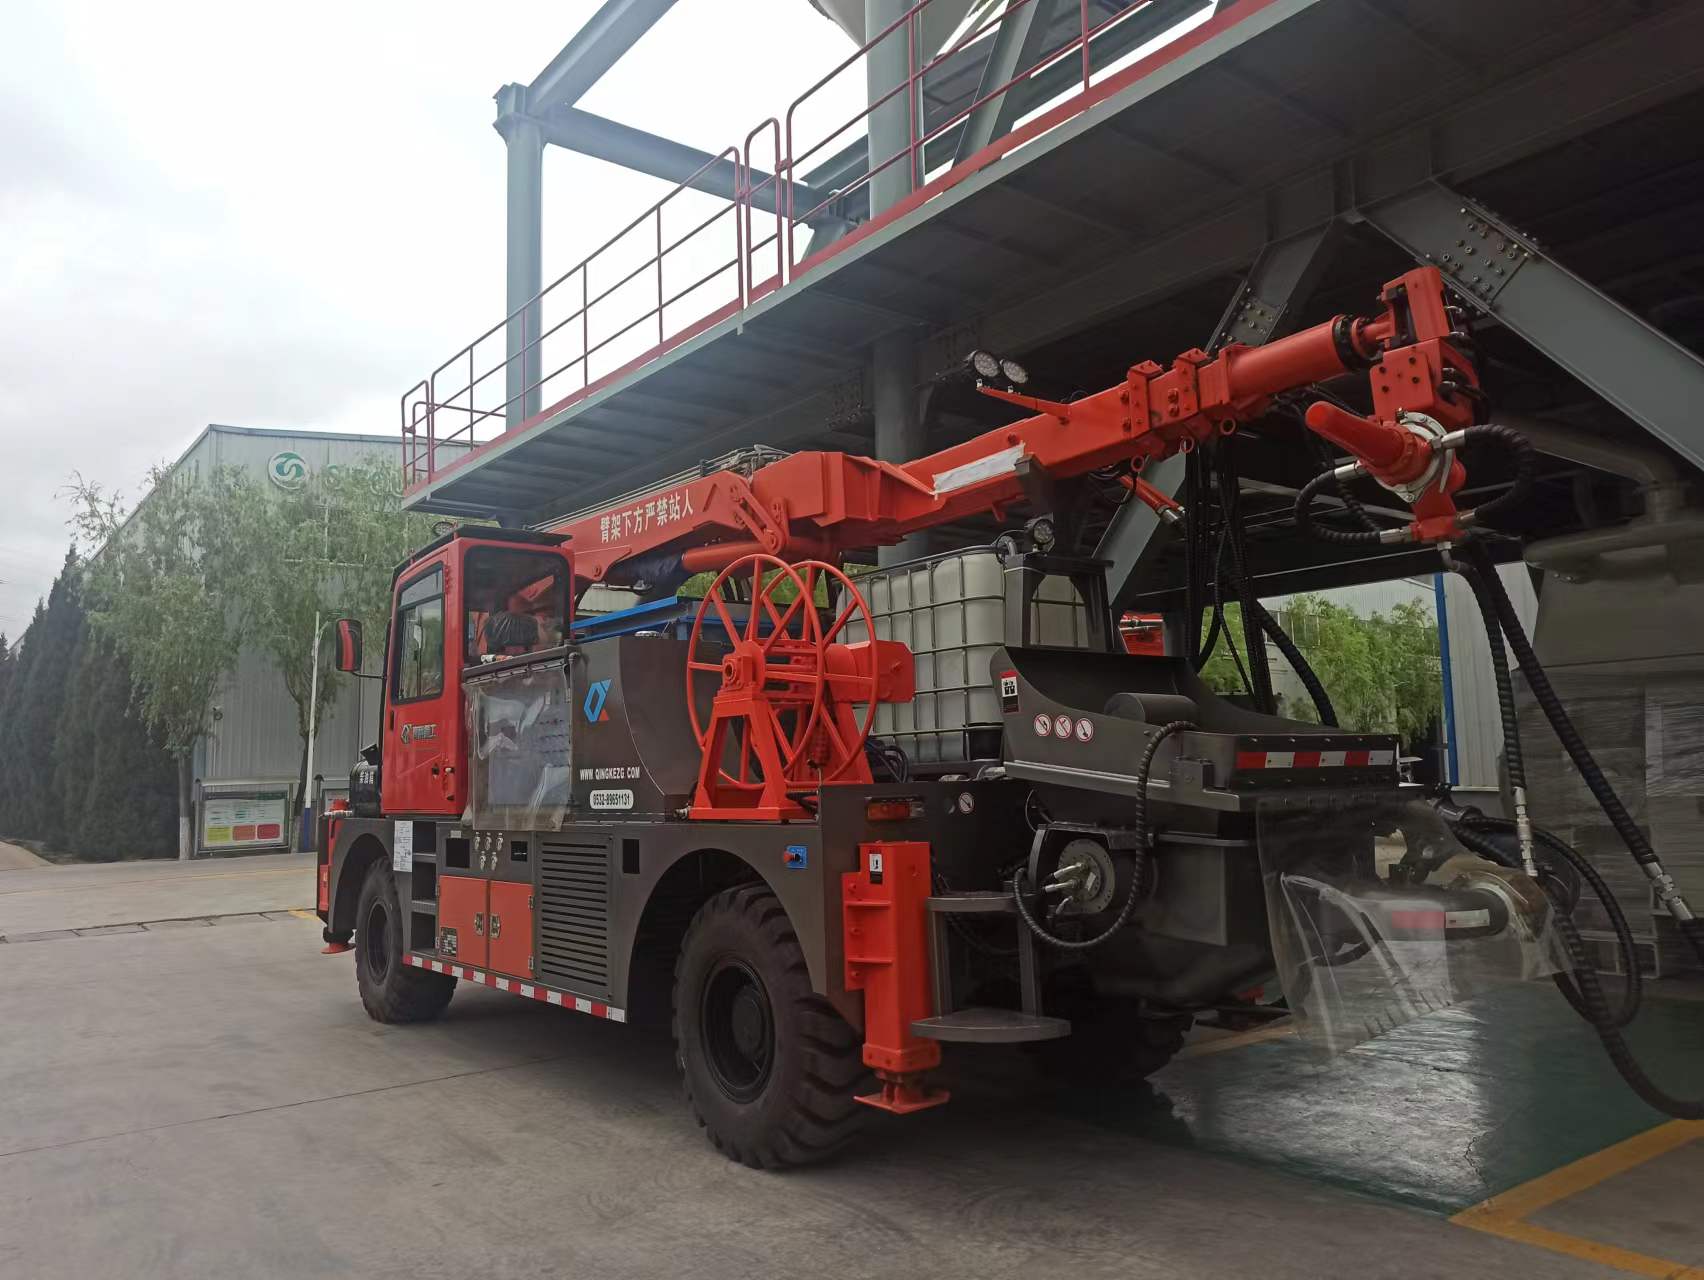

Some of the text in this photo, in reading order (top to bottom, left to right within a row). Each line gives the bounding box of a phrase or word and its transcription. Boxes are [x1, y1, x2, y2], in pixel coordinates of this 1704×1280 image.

[600, 488, 694, 544] 臂架下方严禁站人
